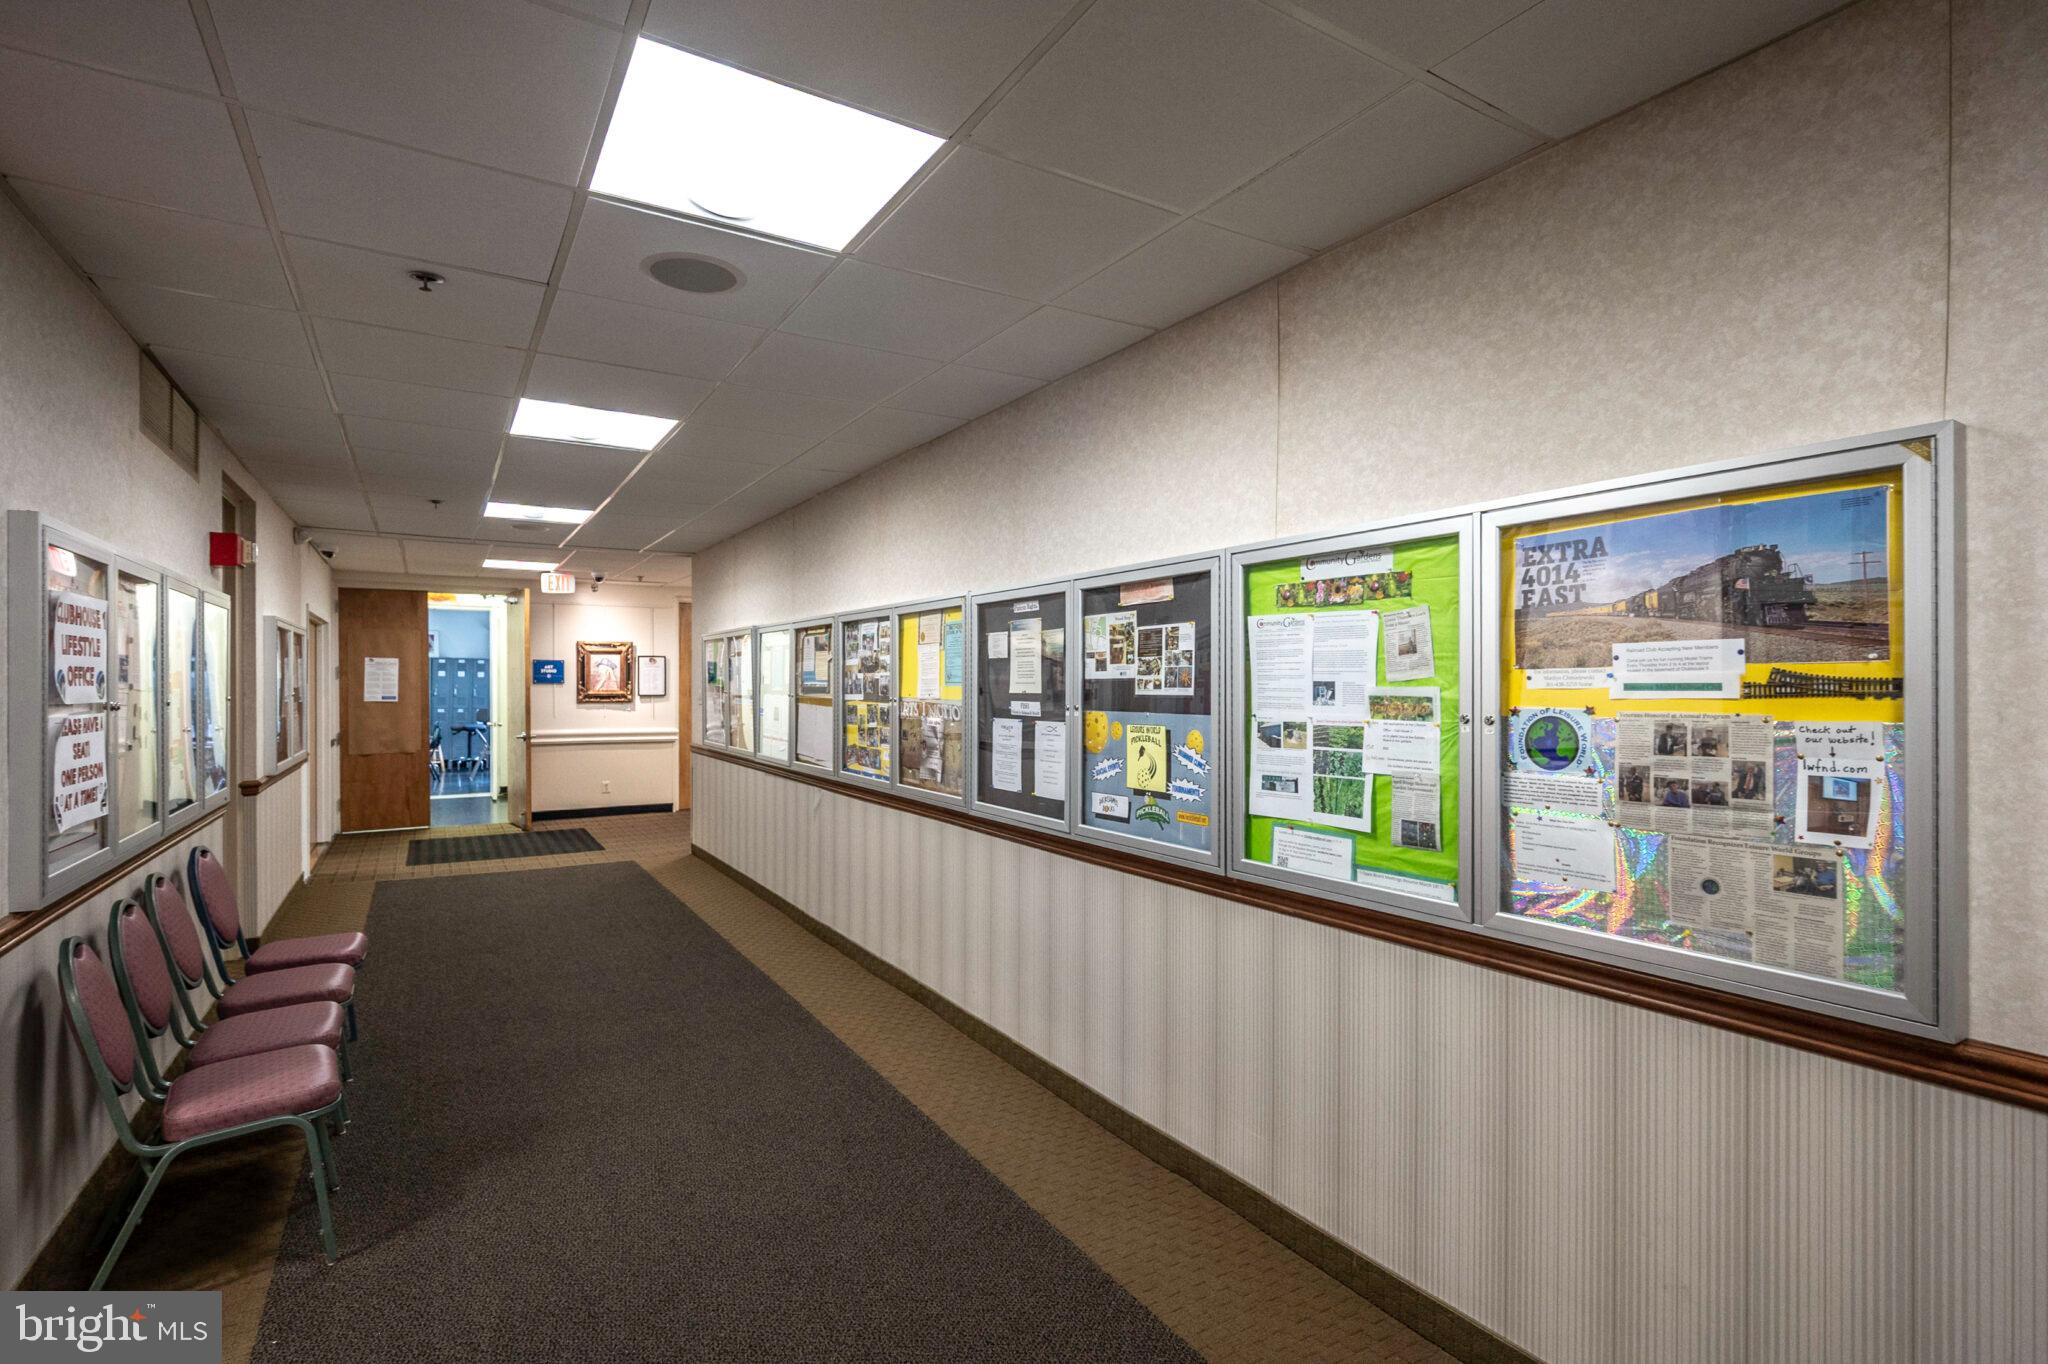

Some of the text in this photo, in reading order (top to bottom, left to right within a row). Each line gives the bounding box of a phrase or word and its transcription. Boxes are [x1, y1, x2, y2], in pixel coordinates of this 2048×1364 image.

[1522, 536, 1608, 567] EXTRA
[548, 575, 571, 592] EXIT
[1521, 562, 1580, 588] 4014
[1521, 583, 1586, 609] EAST
[56, 602, 101, 629] CLUBHOUSE
[61, 634, 101, 658] LIFESTYLE
[67, 665, 95, 687] OFFICE
[62, 717, 82, 737] EASE
[82, 716, 99, 734] HAVE
[1518, 712, 1539, 760] FOUNDATION
[1552, 708, 1584, 730] LEISURE
[1799, 725, 1857, 734] Check out
[1131, 735, 1161, 747] PICKLEBALL
[1828, 731, 1875, 746] website!
[61, 762, 104, 788] ONE PERSON
[1171, 785, 1201, 797] TOURNAMENTS
[63, 793, 73, 813] AT
[73, 792, 79, 809] A
[1136, 805, 1170, 822] PICKLEBALL
[1671, 835, 1822, 858] Foundation Recognizes Leisure World Groups
